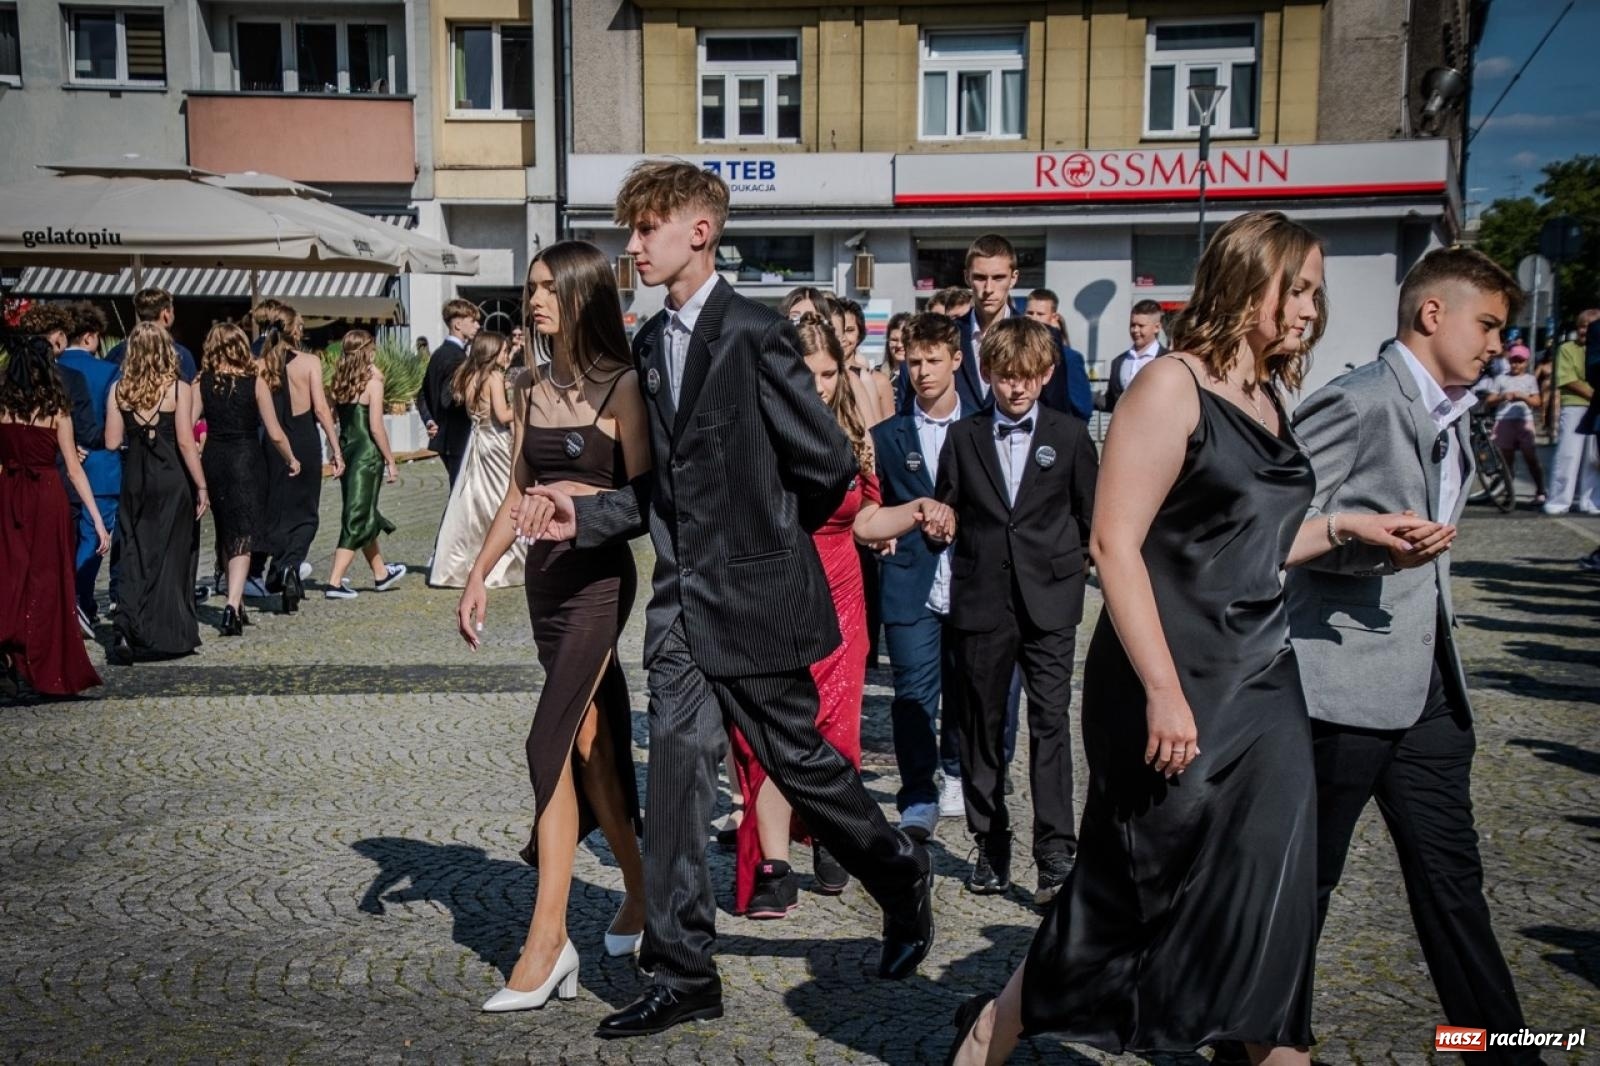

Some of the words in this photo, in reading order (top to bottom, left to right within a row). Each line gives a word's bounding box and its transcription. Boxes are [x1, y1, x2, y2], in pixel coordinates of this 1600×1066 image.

[726, 160, 776, 180] TEB
[1036, 149, 1289, 188] ROSSMANN
[729, 184, 776, 192] DUKACJA
[22, 226, 122, 249] gelatopiu
